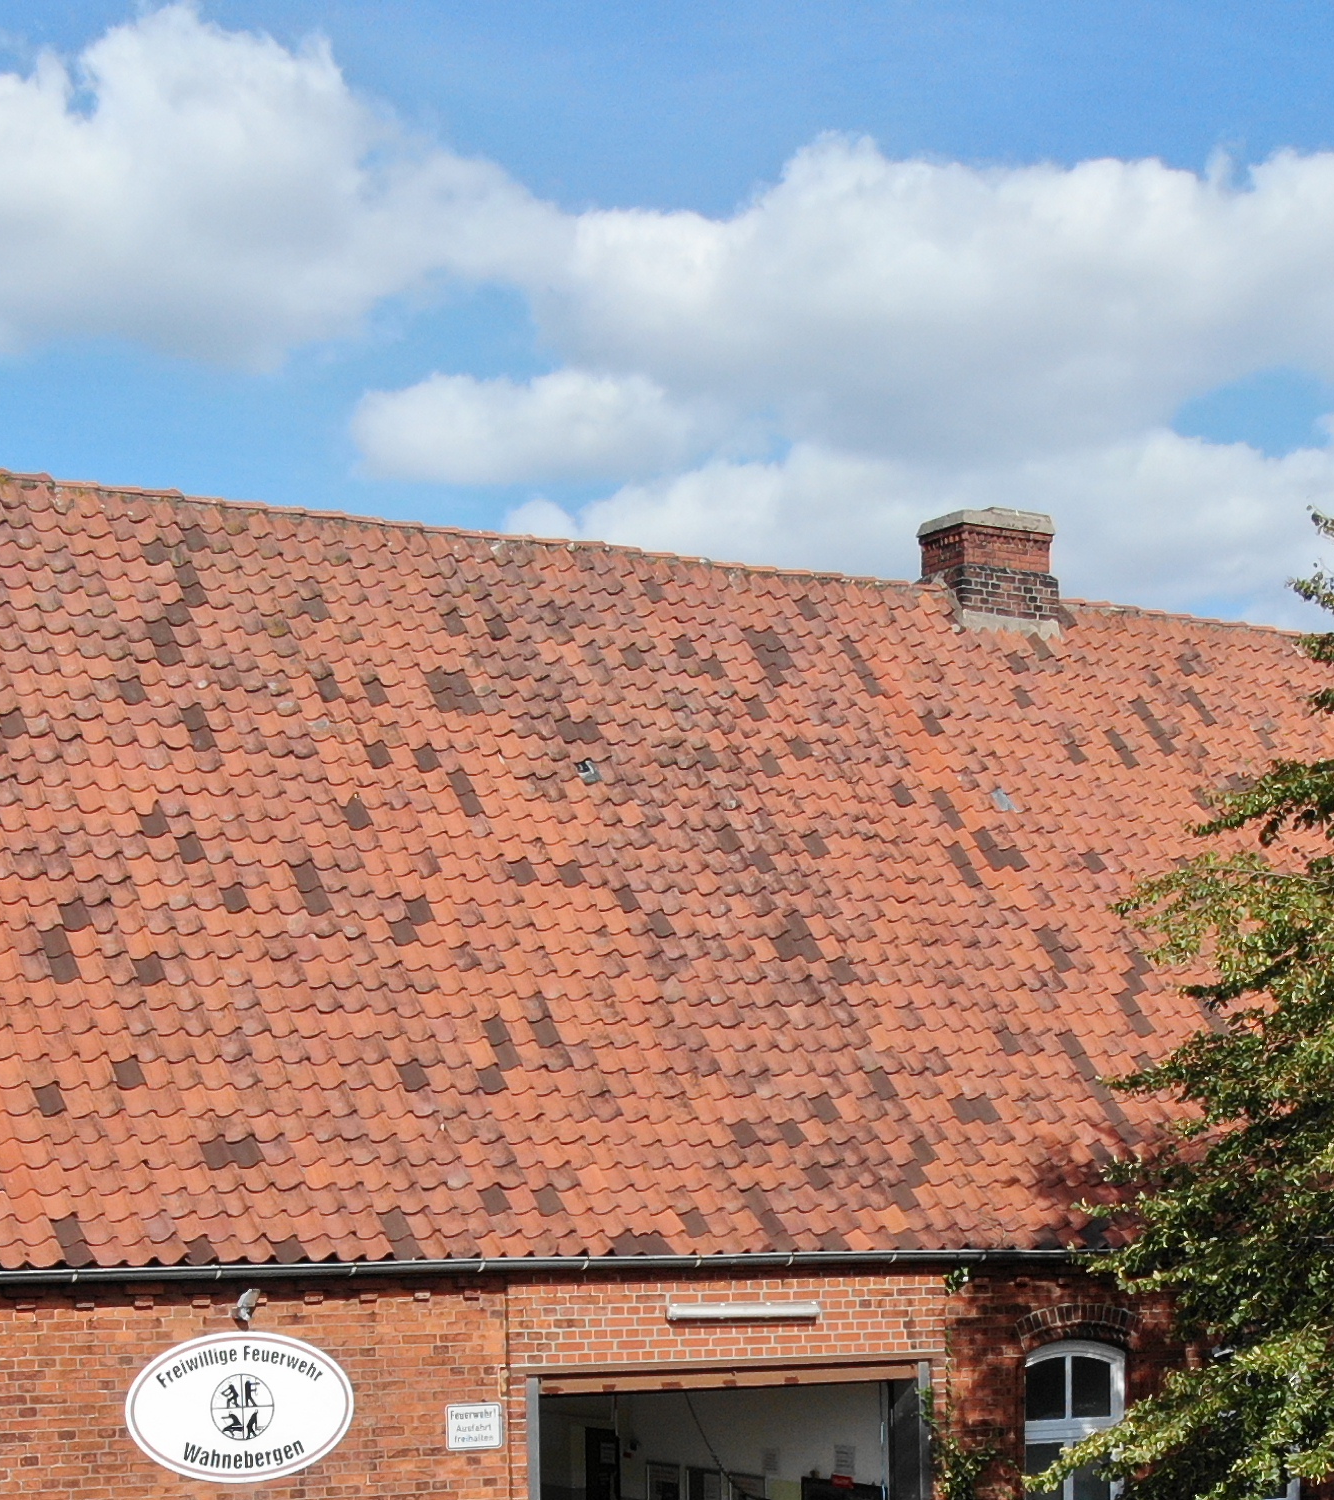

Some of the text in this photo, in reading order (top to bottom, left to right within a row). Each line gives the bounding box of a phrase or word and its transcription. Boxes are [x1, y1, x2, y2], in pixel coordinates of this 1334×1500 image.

[156, 1345, 323, 1388] Freiwillige Feuerwehr
[450, 1408, 496, 1420] Feuerwehr!
[183, 1440, 305, 1469] Wahnebergen
